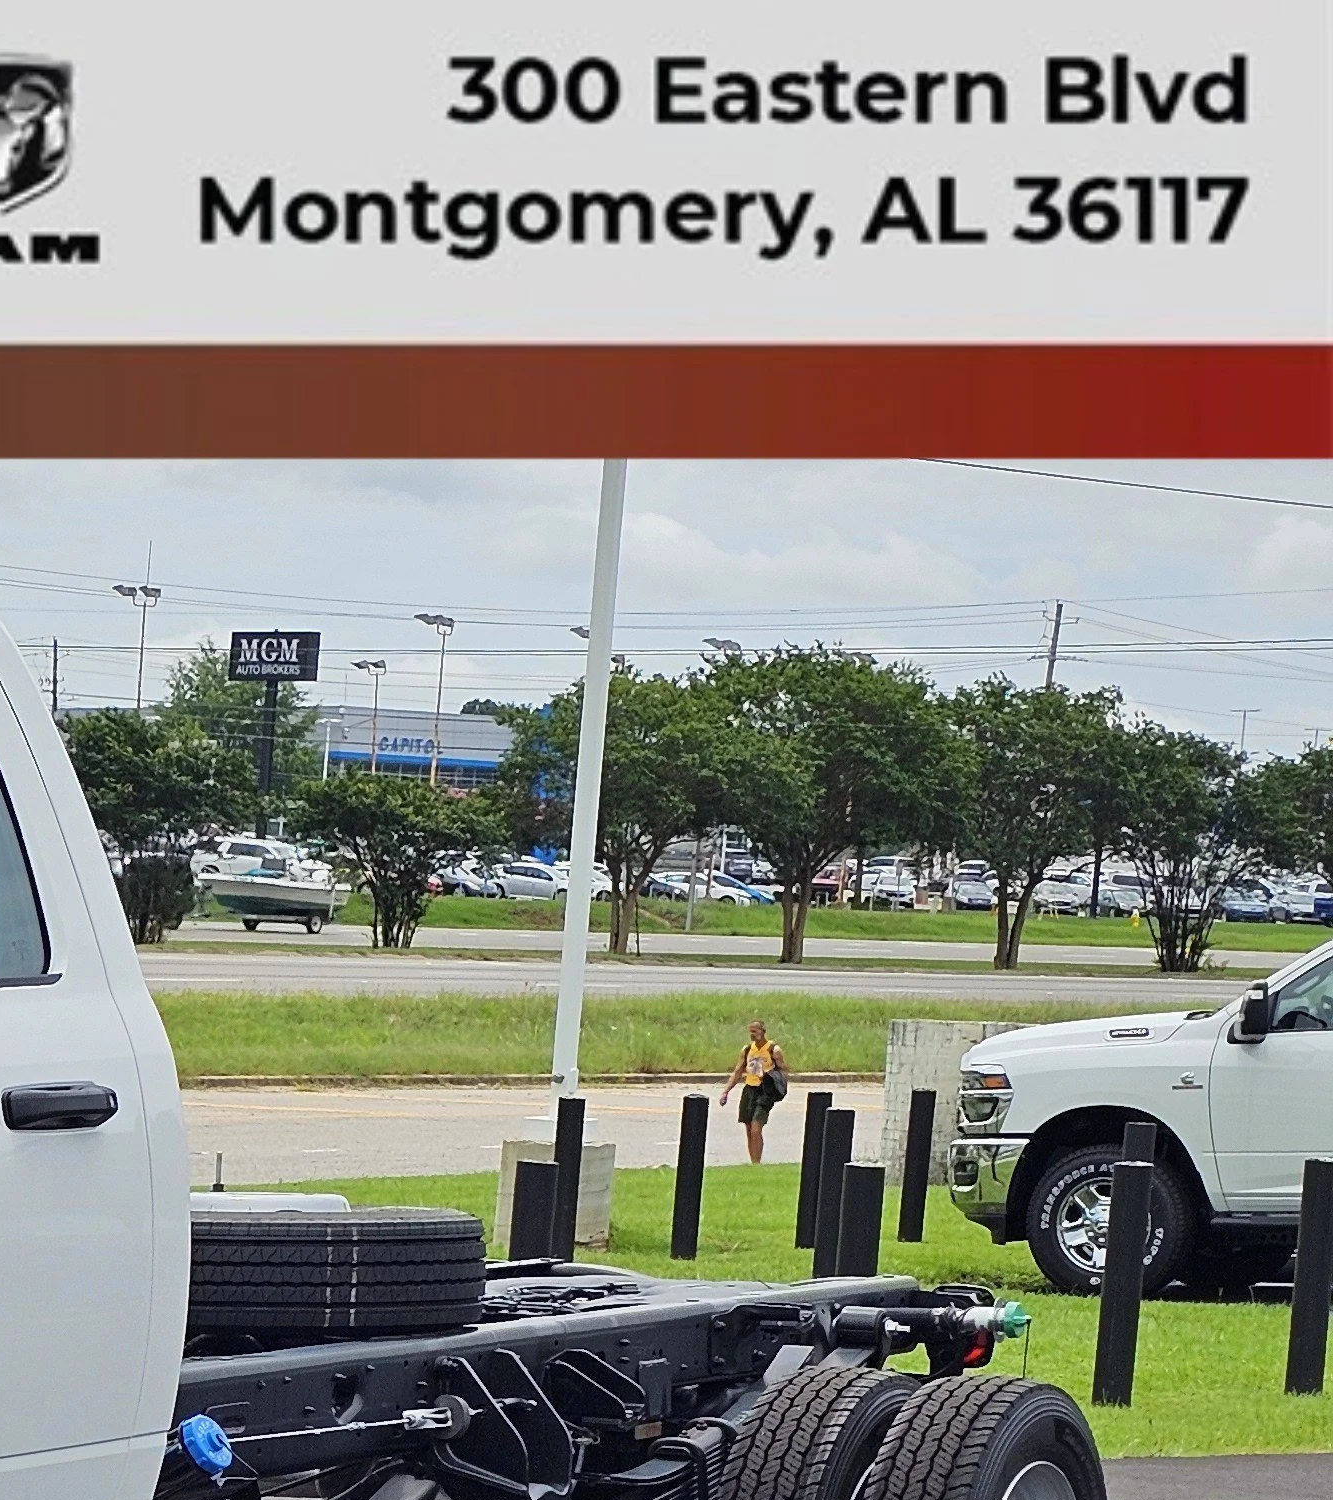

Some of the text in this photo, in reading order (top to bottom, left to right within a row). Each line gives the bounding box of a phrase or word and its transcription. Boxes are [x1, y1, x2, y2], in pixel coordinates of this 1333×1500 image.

[238, 638, 300, 662] MGM
[235, 664, 301, 676] AUTO BROKERS
